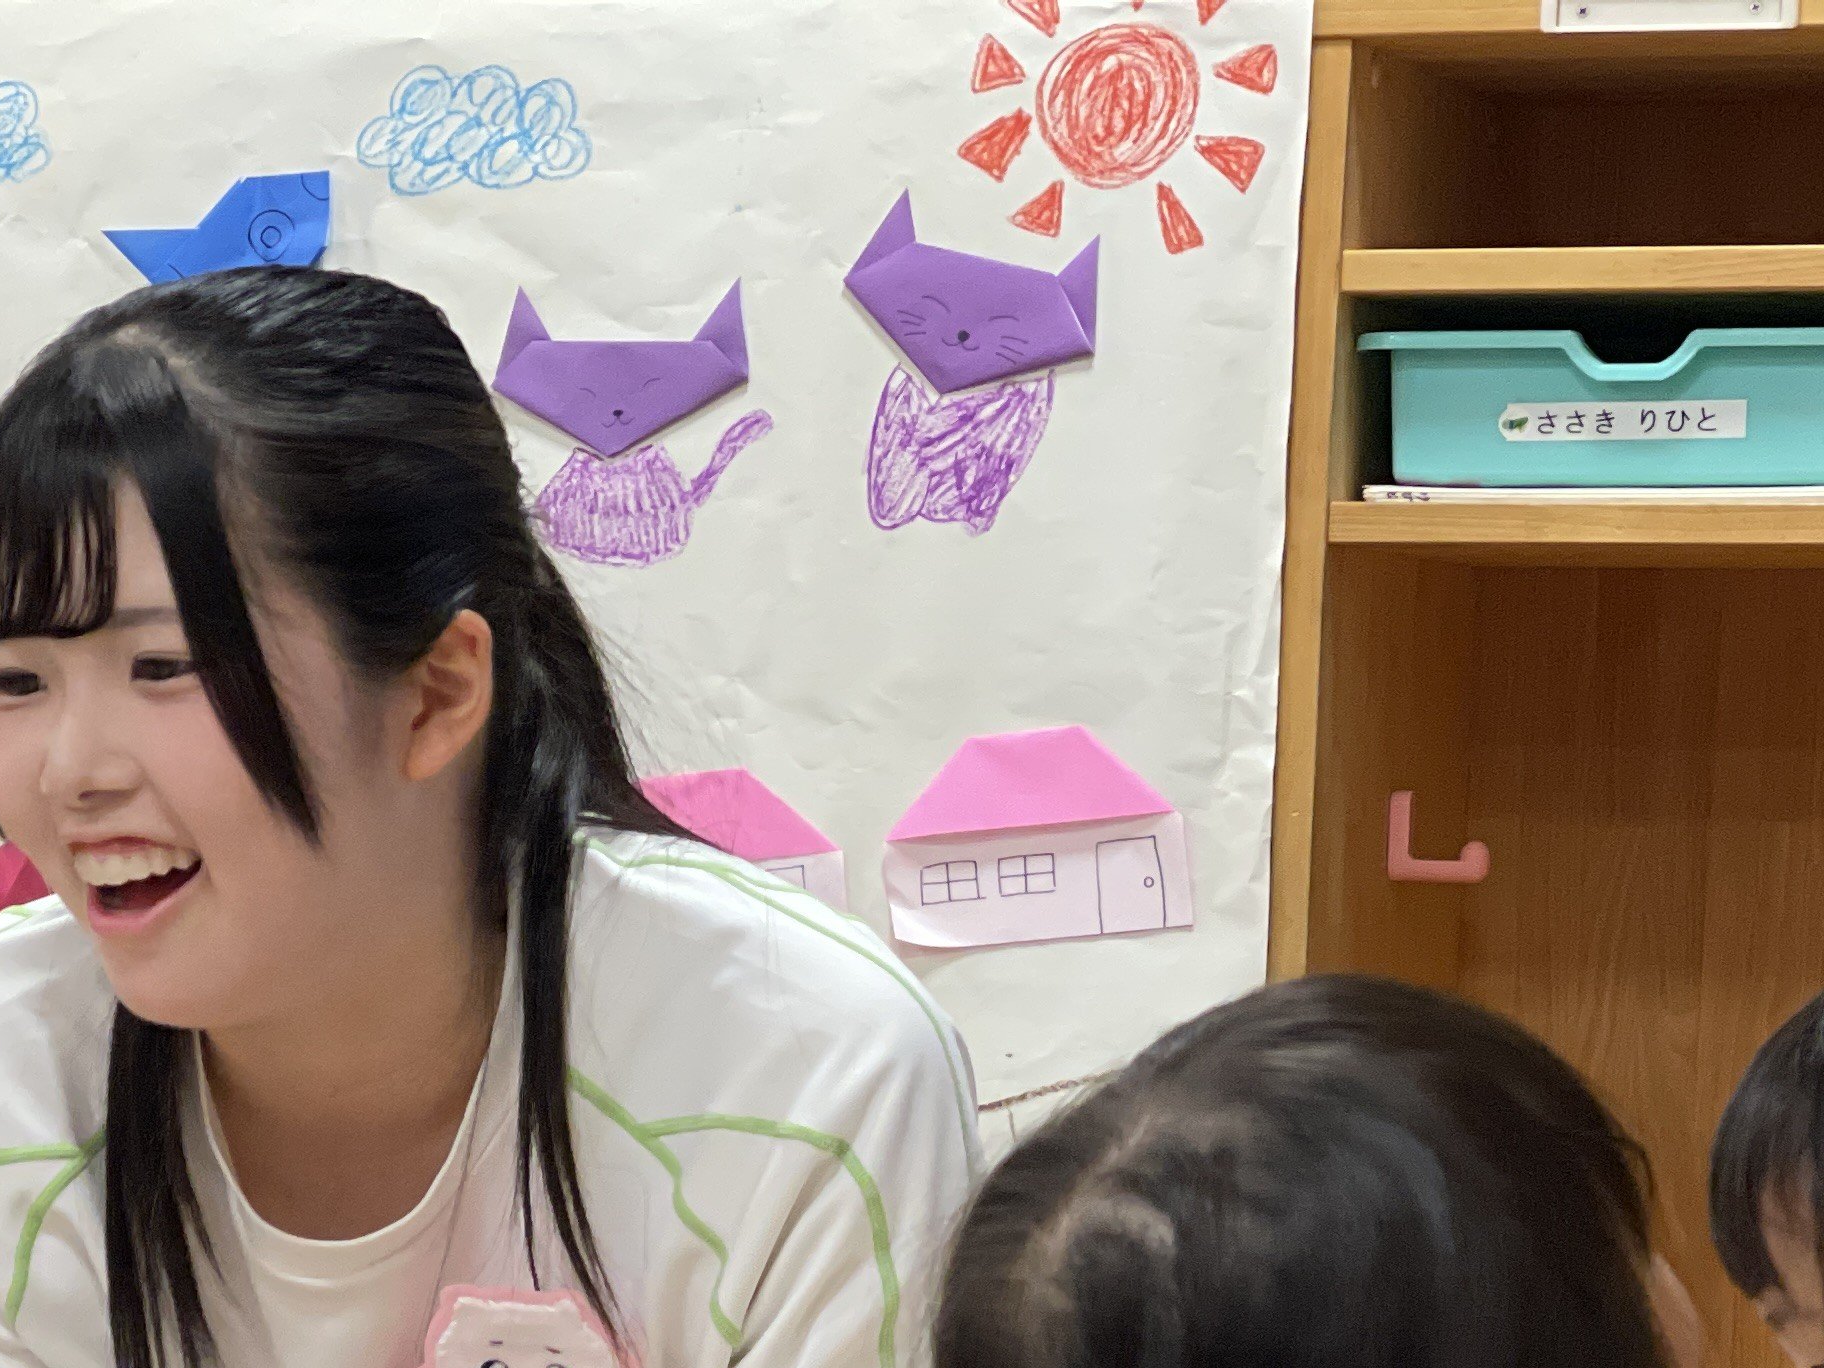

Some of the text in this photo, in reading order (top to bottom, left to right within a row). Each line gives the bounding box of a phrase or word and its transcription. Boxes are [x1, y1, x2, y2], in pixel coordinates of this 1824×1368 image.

[1537, 406, 1717, 435] ささき りひと
